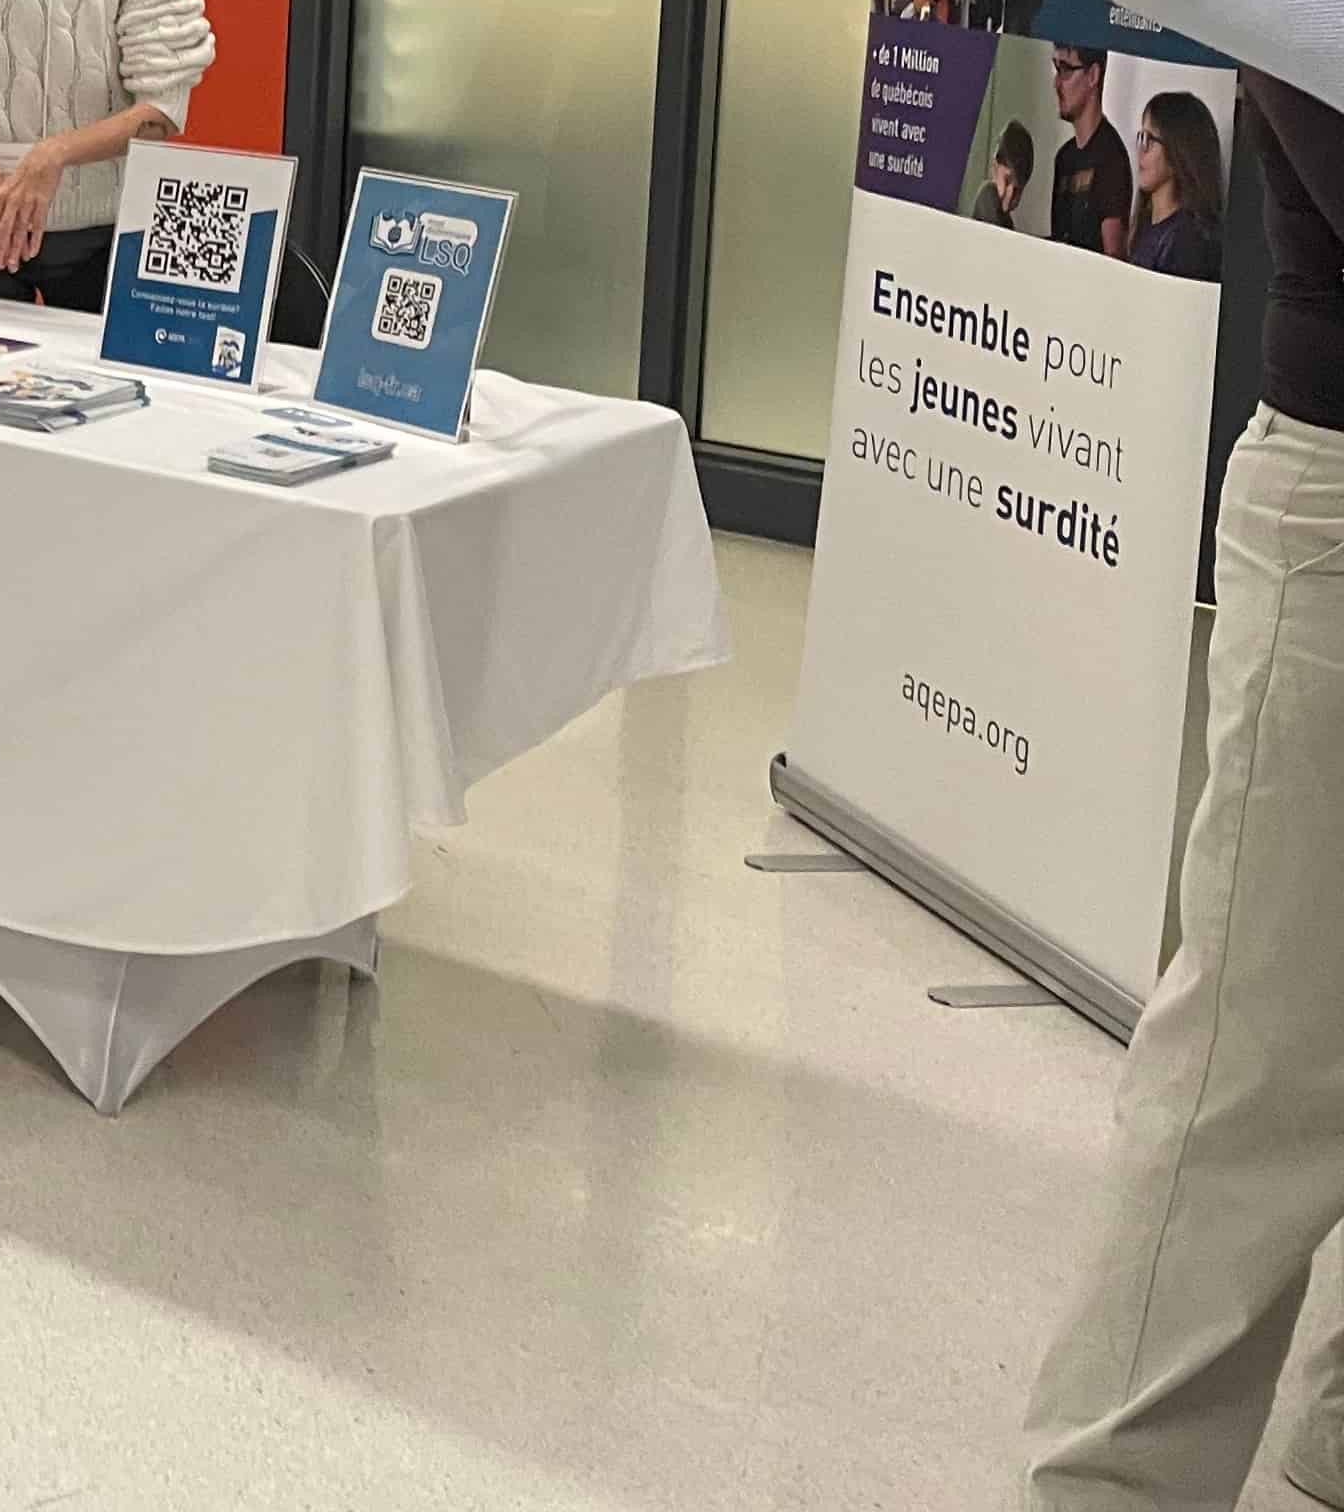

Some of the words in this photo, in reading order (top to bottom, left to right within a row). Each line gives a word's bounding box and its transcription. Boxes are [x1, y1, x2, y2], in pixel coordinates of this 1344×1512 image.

[878, 43, 890, 66] de
[893, 45, 898, 68] 1
[900, 47, 940, 74] Million
[871, 76, 881, 99] de
[881, 82, 934, 108] québécois
[871, 113, 899, 137] vivent
[901, 121, 927, 143] avec
[868, 150, 886, 170] une
[887, 154, 925, 179] surdité
[419, 234, 473, 277] LSQ
[873, 269, 1031, 363] Ensemble
[1043, 334, 1123, 390] pour
[858, 338, 902, 395] les
[909, 358, 1019, 440] jeunes
[1028, 405, 1124, 484] vivant
[851, 426, 918, 480] avec
[926, 455, 984, 509] une
[995, 483, 1122, 568] surdité
[902, 672, 1030, 776] aqepa.org
